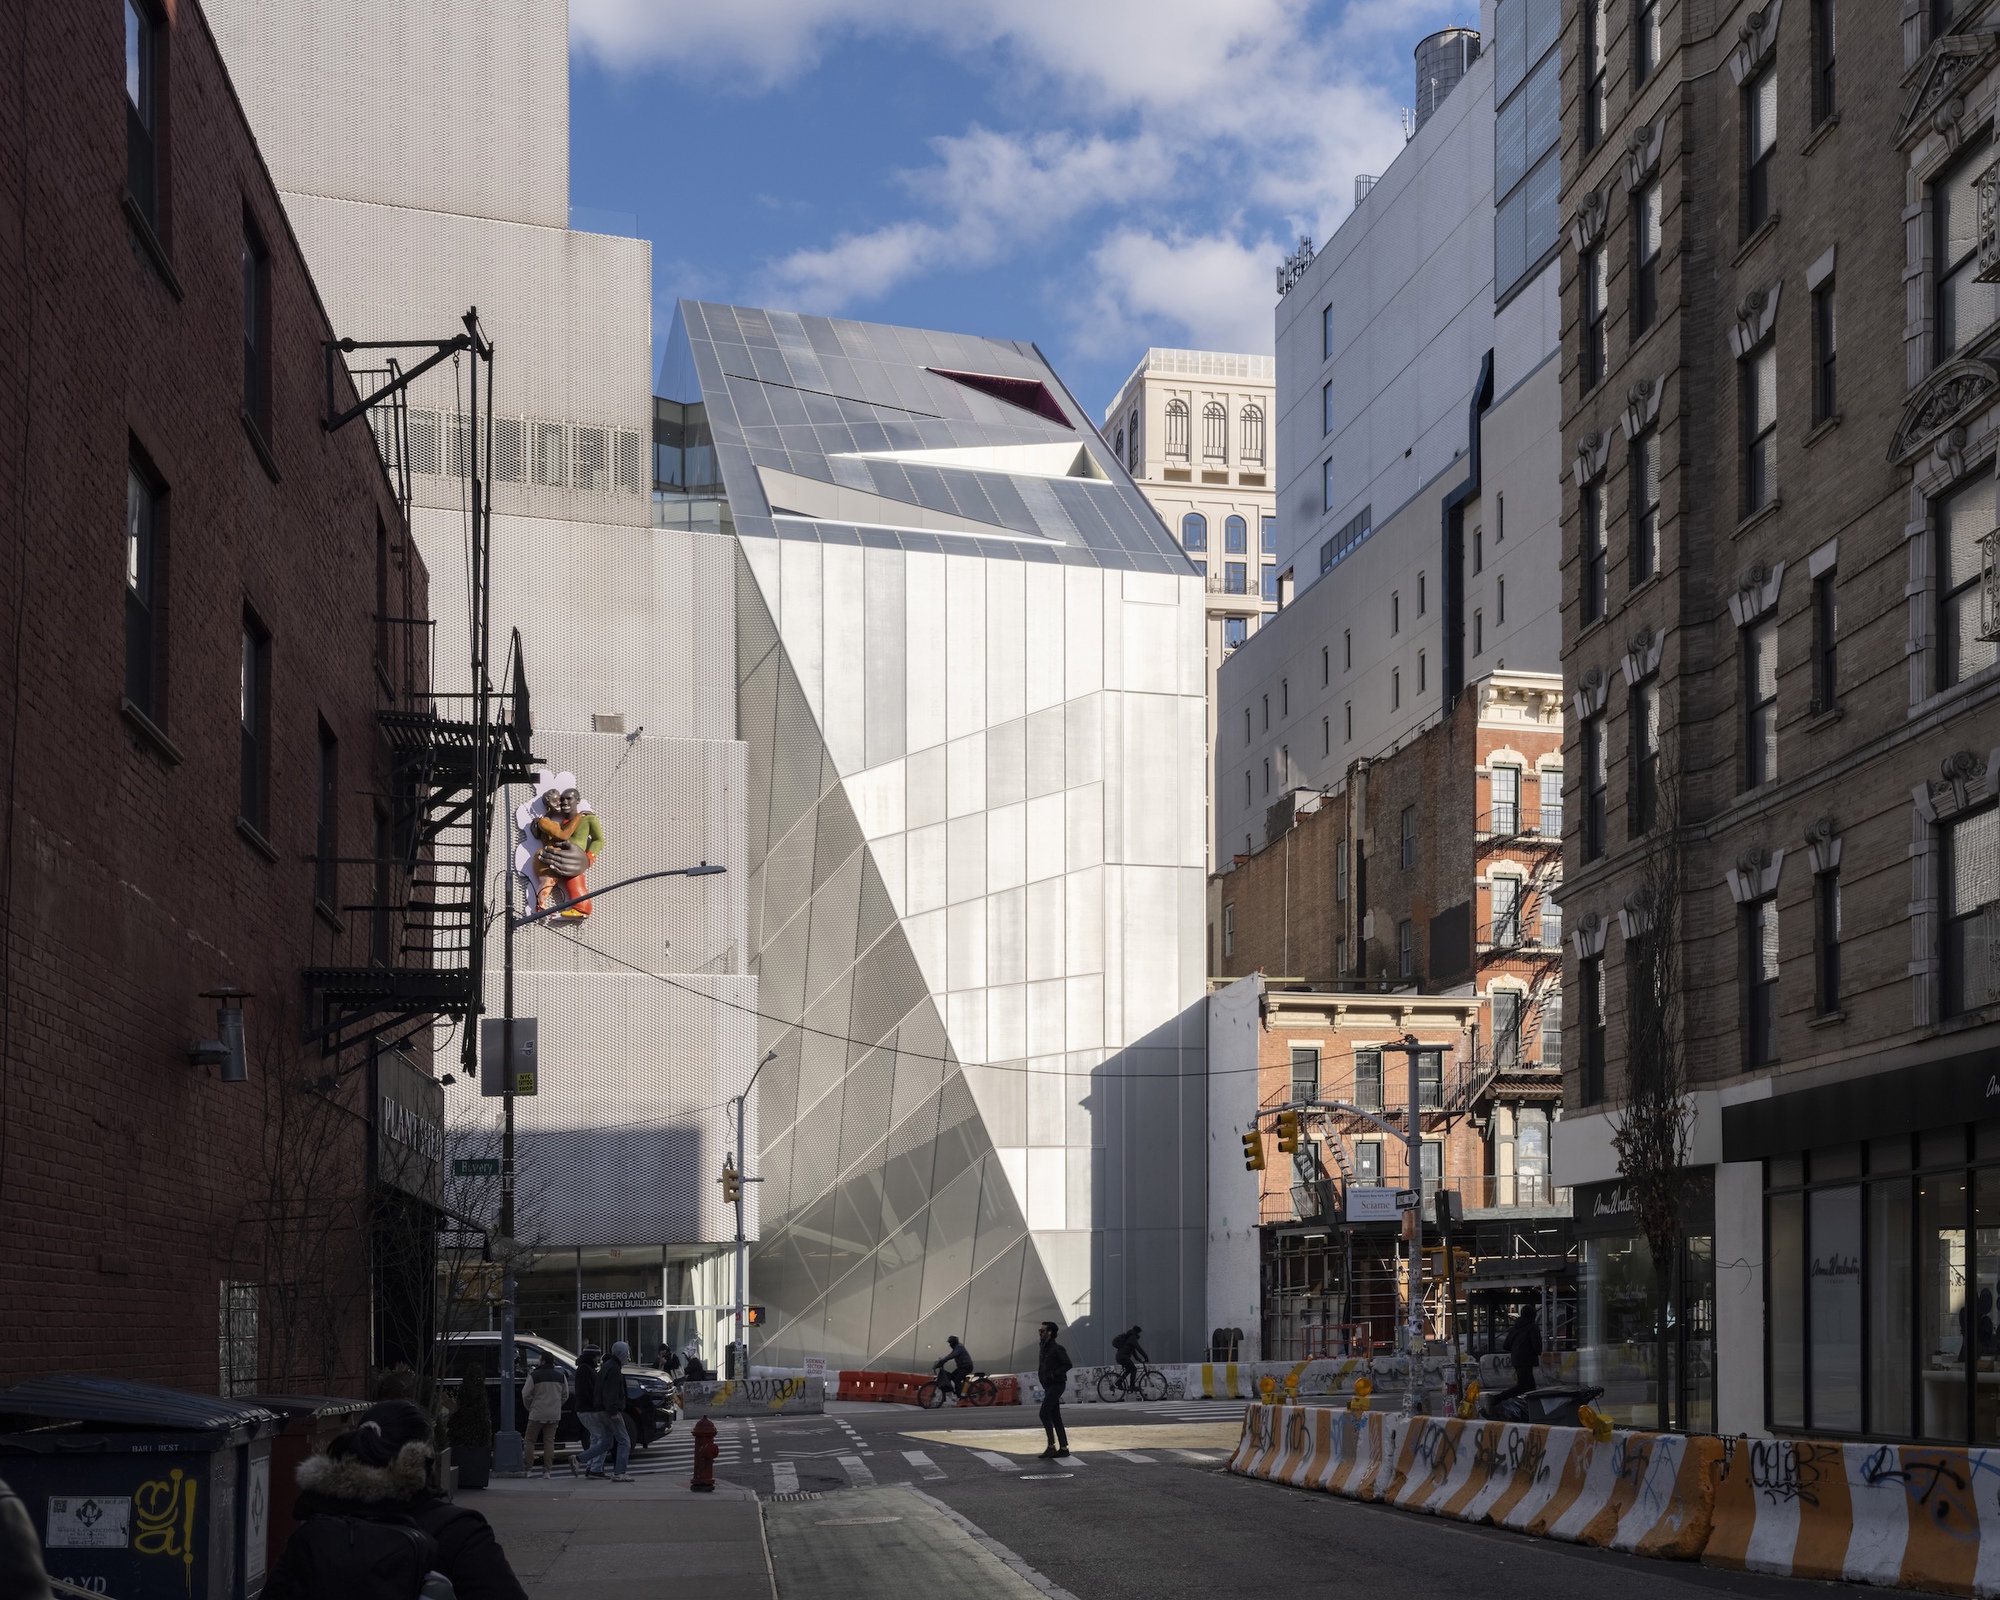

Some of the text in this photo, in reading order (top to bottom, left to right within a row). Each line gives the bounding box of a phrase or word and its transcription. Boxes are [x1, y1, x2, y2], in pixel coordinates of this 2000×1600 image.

[462, 1161, 493, 1175] Bowery
[1361, 1200, 1391, 1209] Sciame
[582, 1291, 646, 1301] EISENBERG AND
[582, 1299, 662, 1309] FEINSTEIN BUILDING
[158, 1444, 179, 1452] REST
[80, 1576, 107, 1595] YD
